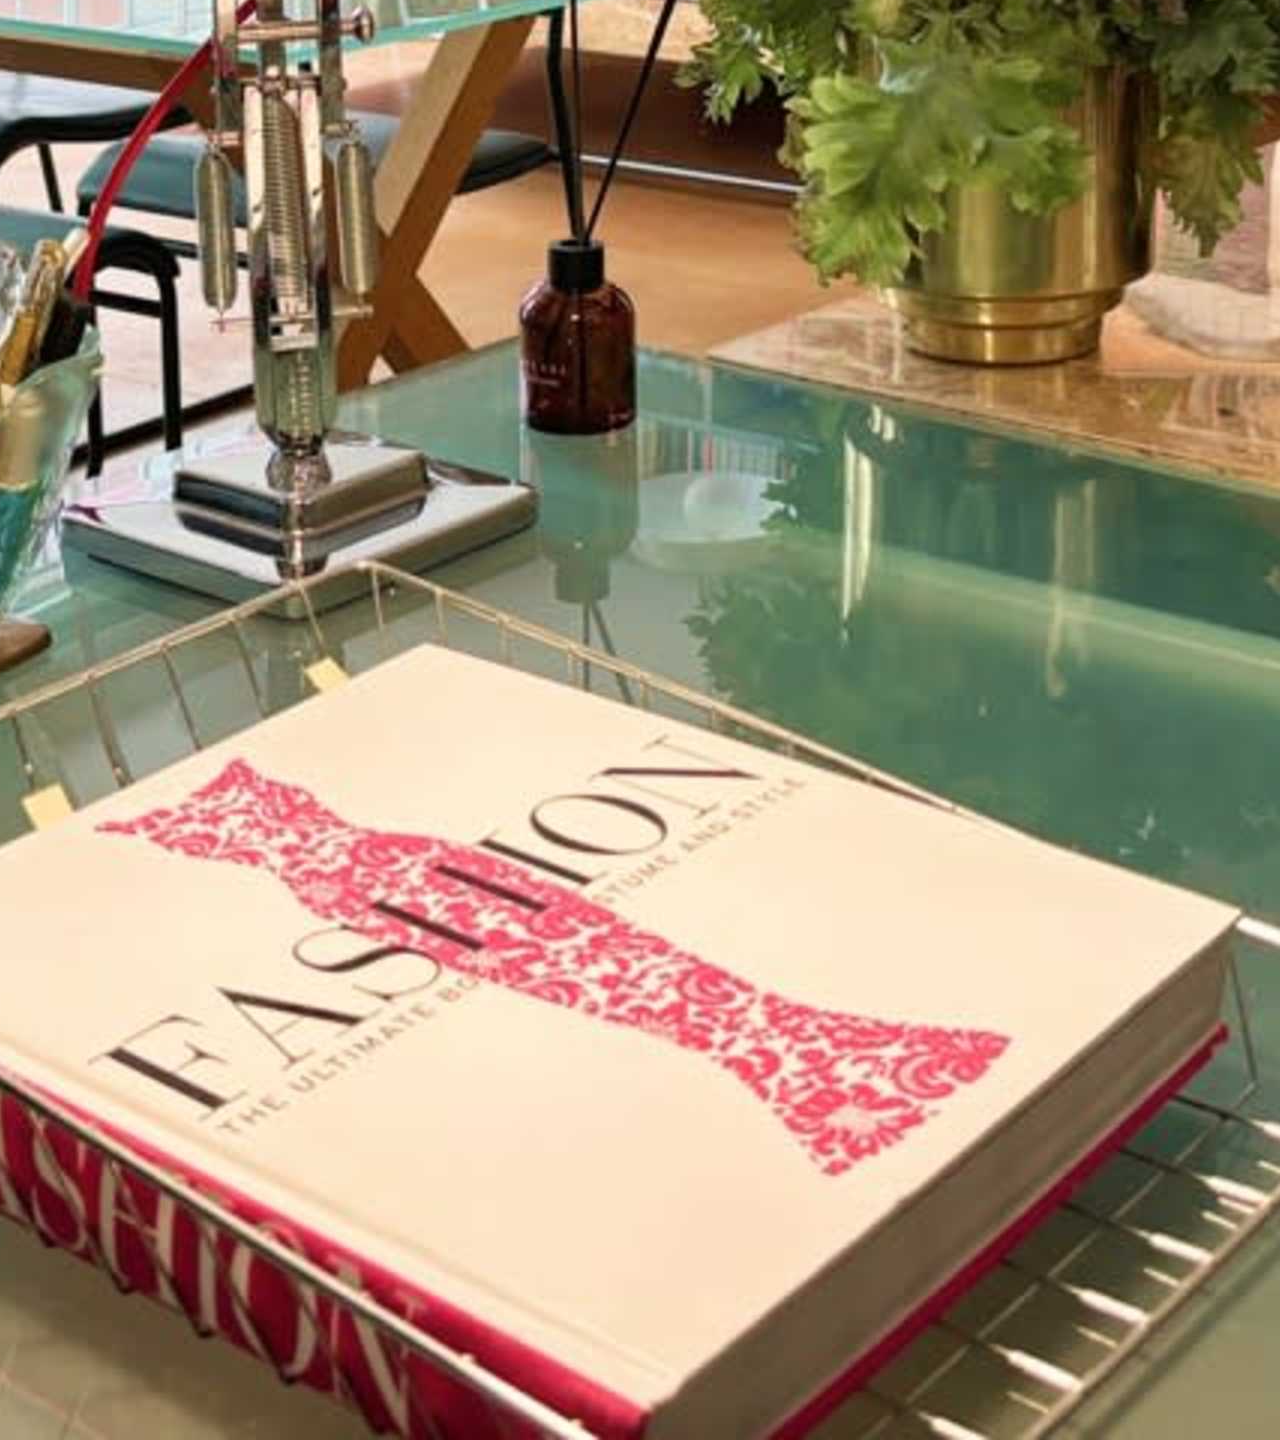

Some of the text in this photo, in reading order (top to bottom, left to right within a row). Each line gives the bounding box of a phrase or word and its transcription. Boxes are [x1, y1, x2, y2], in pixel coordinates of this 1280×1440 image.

[678, 822, 732, 853] AND
[730, 777, 807, 820] STYLE
[87, 734, 762, 1123] FASHION
[217, 1091, 291, 1135] THE
[287, 1003, 437, 1094] ULTIMATE
